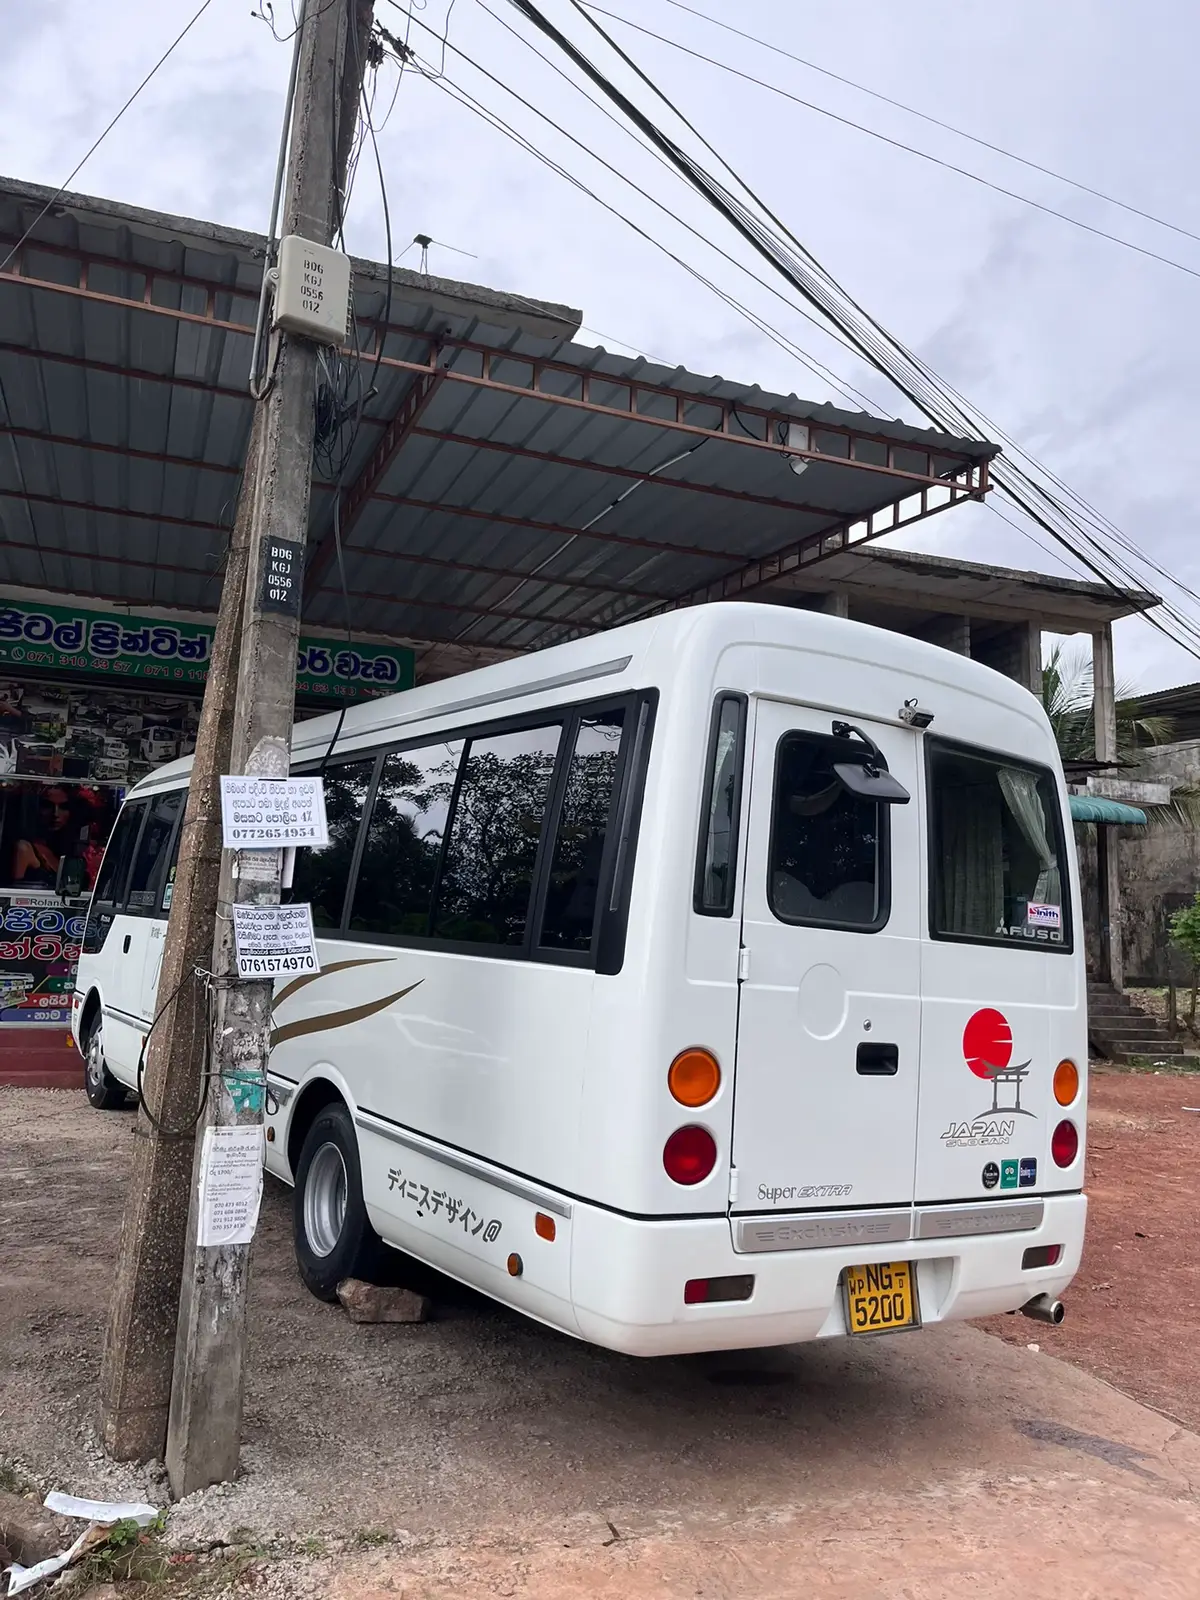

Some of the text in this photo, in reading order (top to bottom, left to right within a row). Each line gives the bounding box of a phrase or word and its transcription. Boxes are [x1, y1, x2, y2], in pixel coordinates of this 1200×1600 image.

[303, 259, 324, 274] BDG
[304, 273, 322, 287] KGJ
[300, 285, 324, 301] 0556
[302, 299, 320, 314] 012
[271, 546, 293, 561] BDG
[271, 560, 291, 574] KGJ
[268, 574, 292, 588] 0556
[269, 588, 287, 602] 012
[27, 651, 54, 663] 071
[59, 654, 88, 667] 310
[113, 660, 132, 672] 57
[144, 664, 169, 676] 071
[174, 667, 183, 678] 9
[232, 827, 316, 839] 0772654954
[1010, 926, 1061, 941] FUSO
[240, 955, 314, 972] 0761574970
[939, 1120, 1015, 1139] JAPAN
[945, 1137, 1010, 1147] SLOGAN
[757, 1183, 853, 1204] Super EXTRA
[849, 1278, 865, 1296] WP
[855, 1292, 905, 1327] 5200
